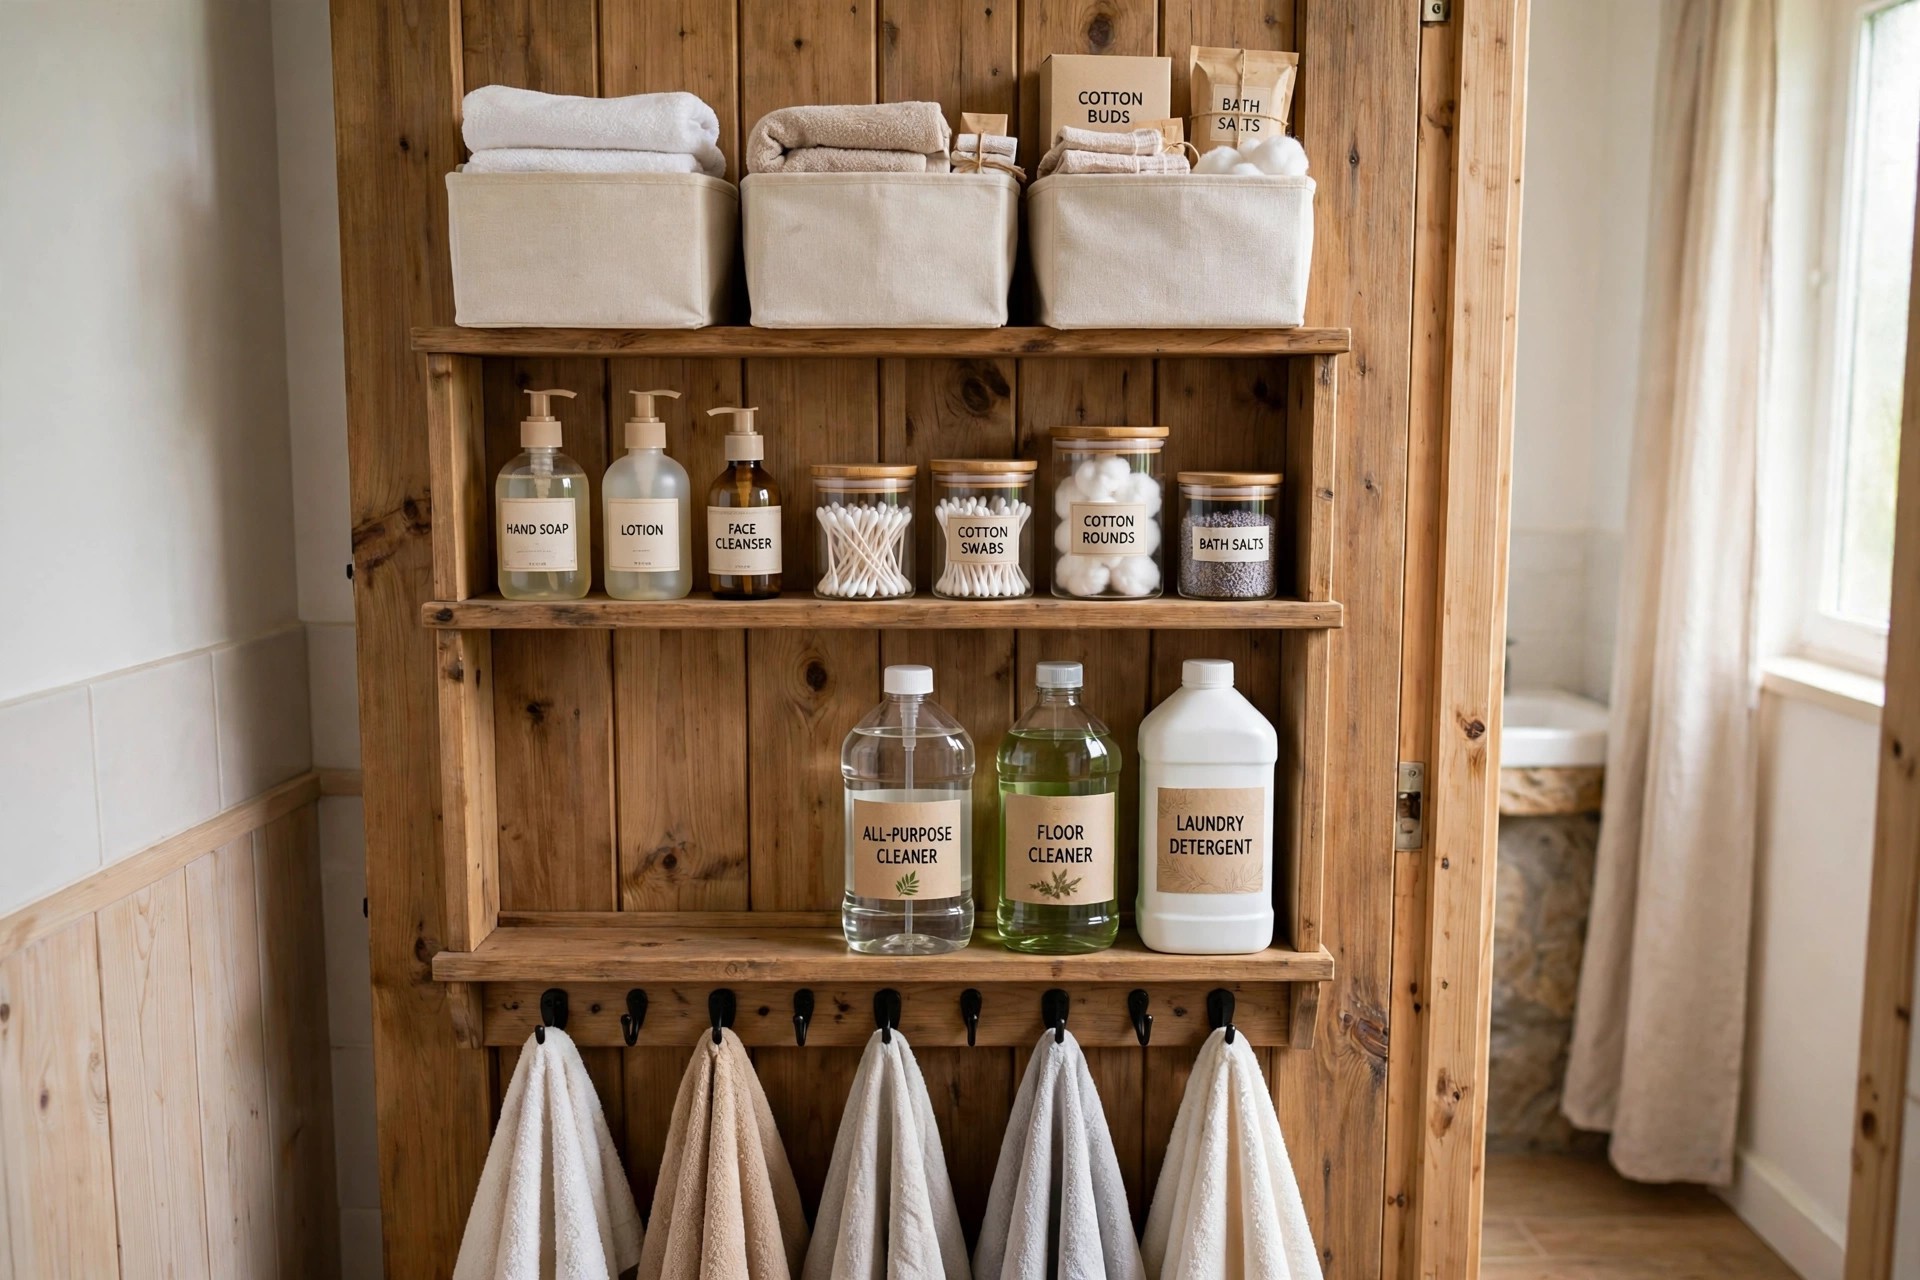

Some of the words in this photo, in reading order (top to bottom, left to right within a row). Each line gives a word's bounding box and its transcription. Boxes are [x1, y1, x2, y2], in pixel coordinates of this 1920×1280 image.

[1078, 91, 1143, 106] COTTON
[1222, 98, 1260, 113] BATH
[1088, 110, 1130, 124] BUDS
[1218, 117, 1260, 132] SATS
[1083, 514, 1134, 528] COTTON
[506, 523, 537, 535] HAND
[539, 523, 569, 535] SOAP
[621, 524, 664, 536] LOTION
[728, 523, 756, 535] FACE
[957, 526, 1008, 539] COTTON
[715, 538, 772, 550] CLEANSER
[1082, 531, 1135, 545] ROUNDS
[1199, 537, 1229, 551] BATH
[1231, 537, 1264, 550] SALTS
[961, 541, 1004, 555] SWABS
[1176, 814, 1245, 833] LAUNDRY
[862, 826, 953, 843] ALL-PURPOSE
[1036, 824, 1085, 841] FLOOR
[1169, 838, 1253, 856] DETERGENT
[876, 848, 938, 865] CLEANER
[1027, 846, 1094, 864] CLEANER
